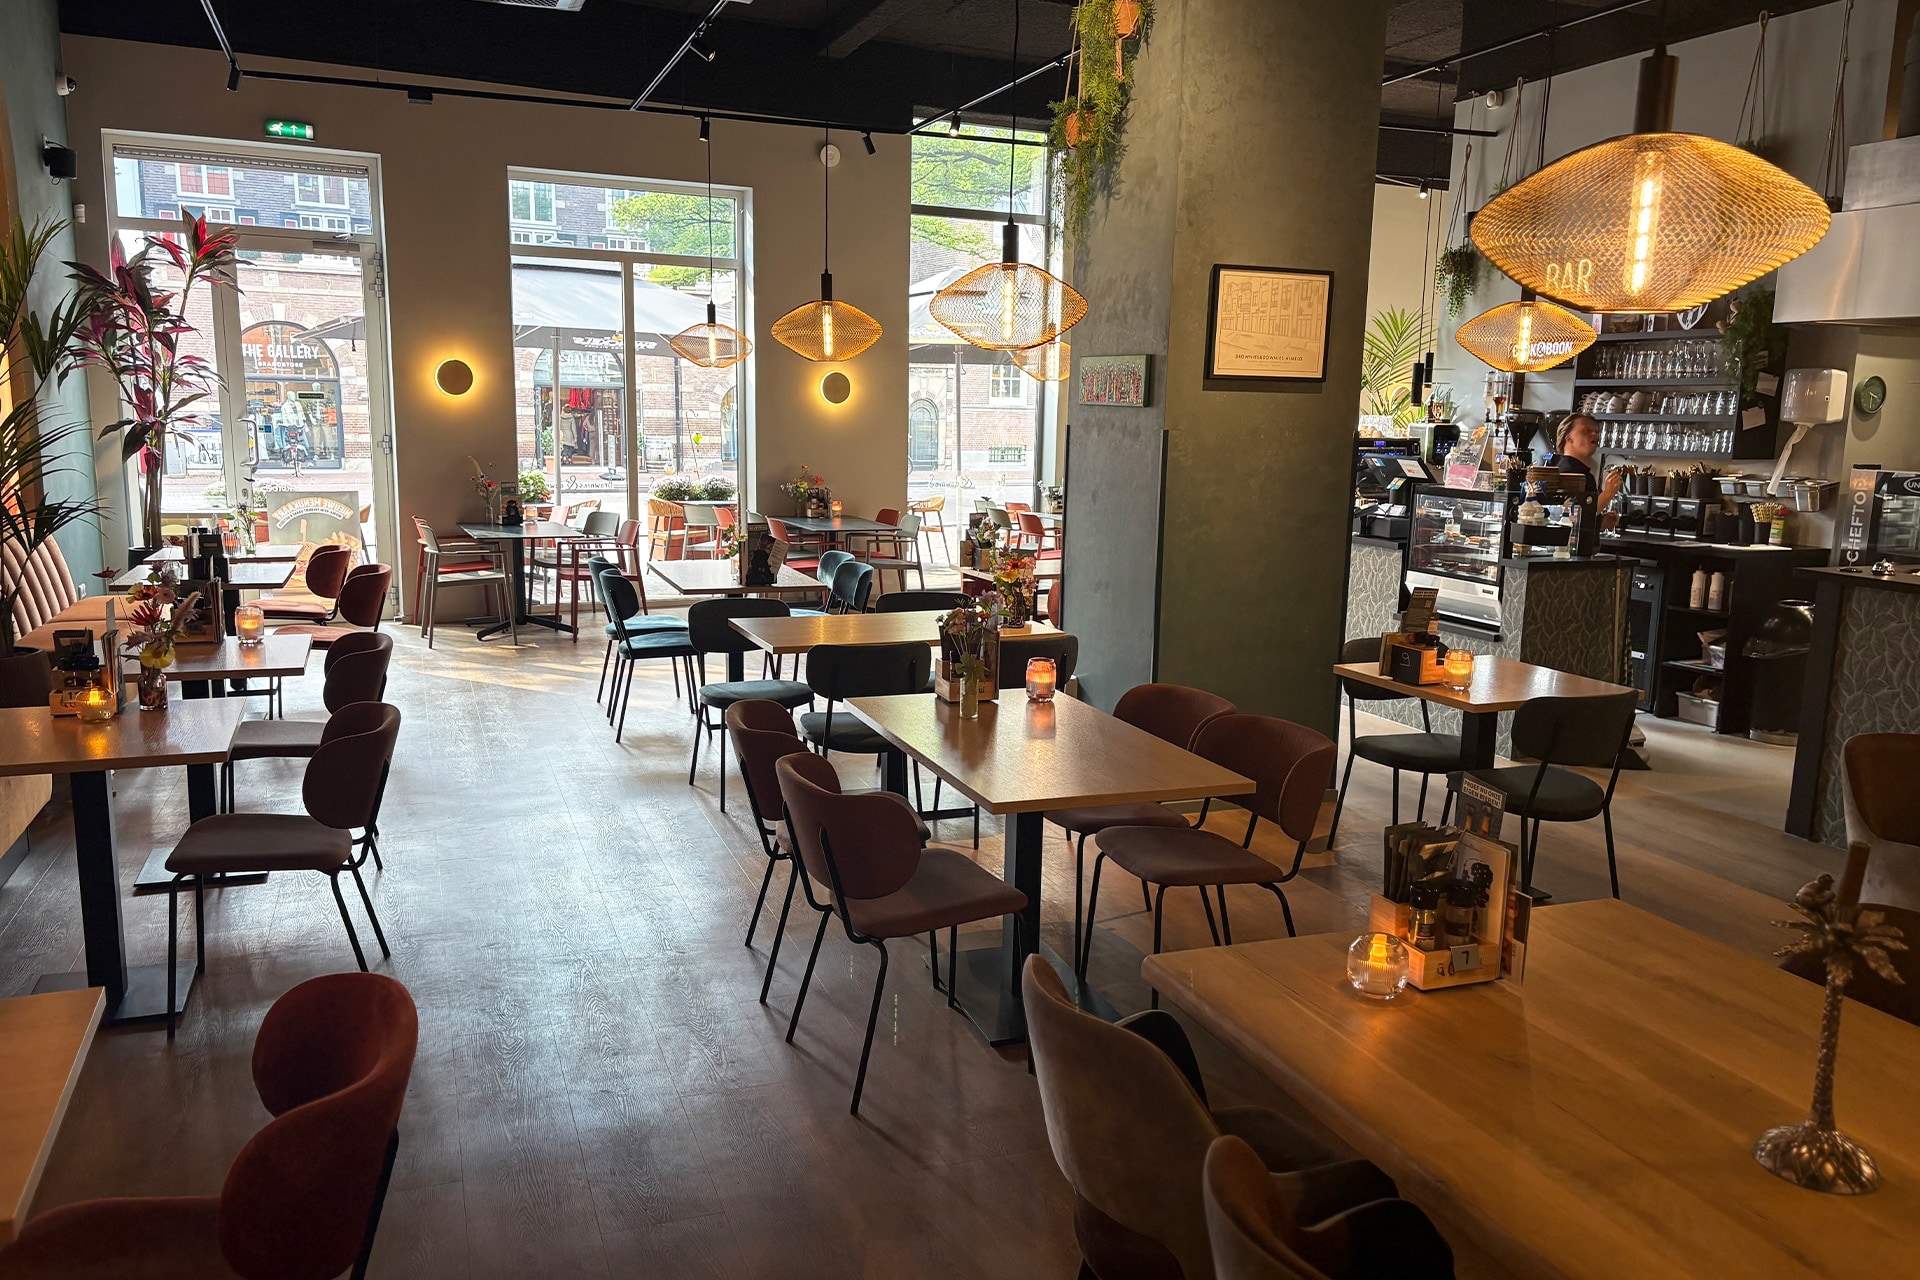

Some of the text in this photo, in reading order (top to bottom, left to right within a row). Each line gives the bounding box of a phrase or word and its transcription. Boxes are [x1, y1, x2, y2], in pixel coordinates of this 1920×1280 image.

[242, 343, 319, 359] THE GALLERY
[1846, 479, 1868, 562] CHEFTOP
[1461, 951, 1470, 964] 7
